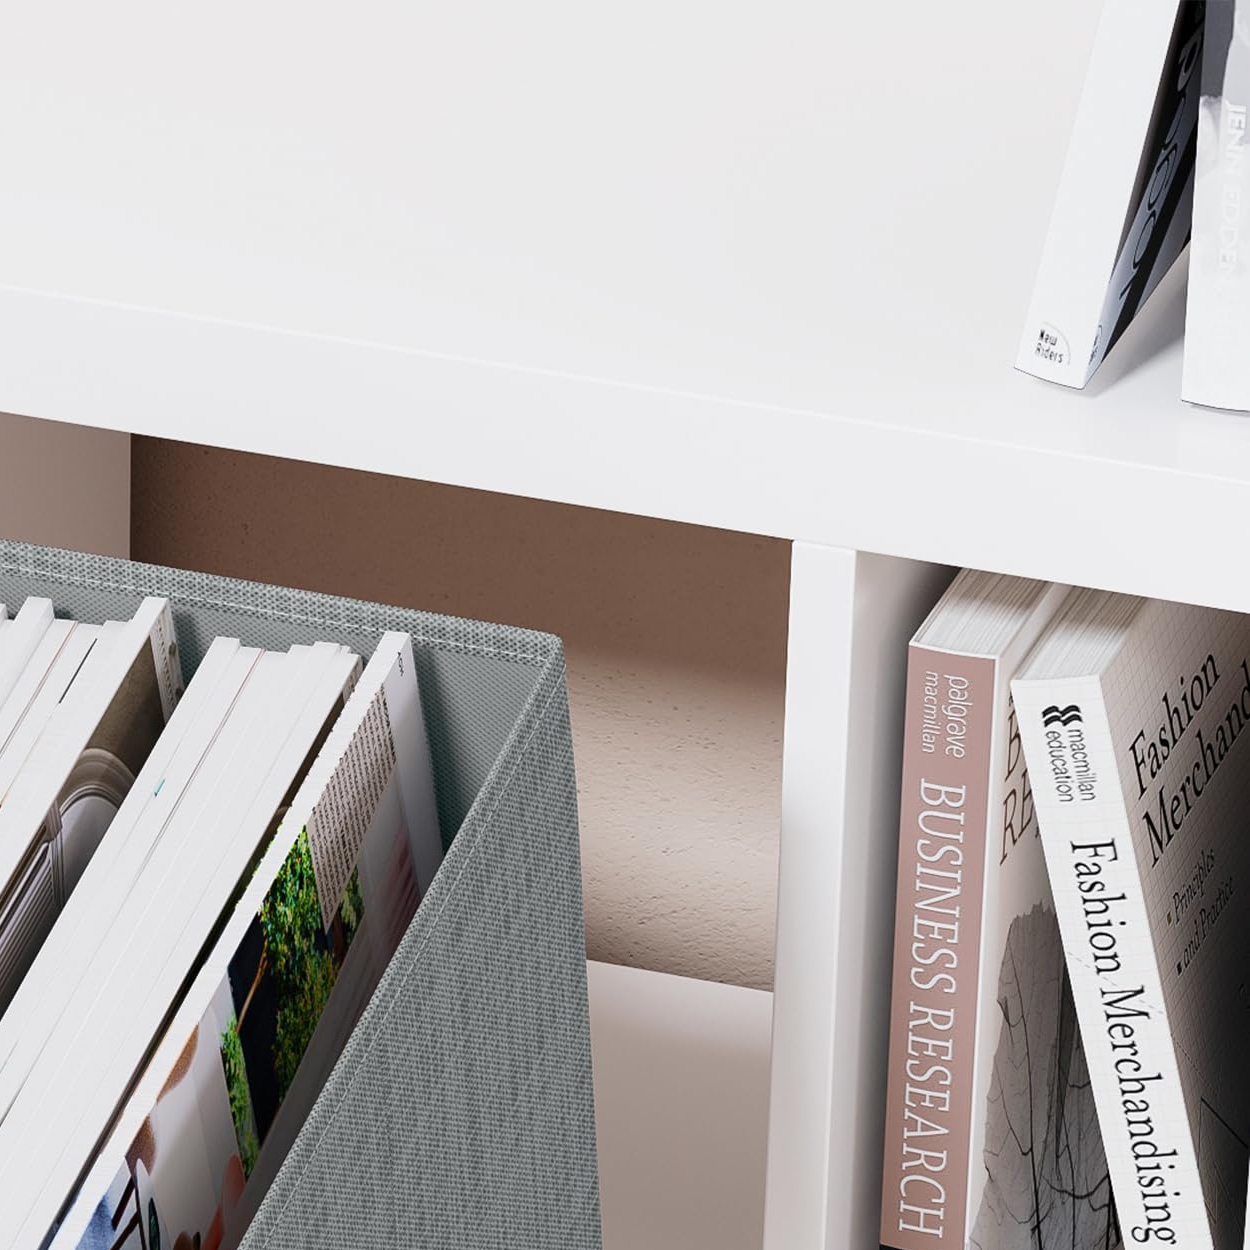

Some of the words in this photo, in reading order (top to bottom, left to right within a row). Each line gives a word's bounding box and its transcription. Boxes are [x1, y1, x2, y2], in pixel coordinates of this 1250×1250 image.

[1035, 342, 1063, 363] Riders
[1038, 329, 1057, 346] New
[921, 671, 941, 753] macmillan
[941, 674, 973, 758] palgrave
[1129, 653, 1220, 800] Fashion
[1045, 730, 1074, 802] education
[1067, 729, 1097, 801] macmillan
[909, 778, 966, 994] BUSINESS
[1173, 848, 1215, 925] Principles
[1183, 921, 1201, 969] and
[1199, 876, 1235, 940] Practice
[1070, 837, 1127, 976] Fashion
[1100, 985, 1180, 1247] Merchandising
[899, 1001, 955, 1239] RESEARCH
